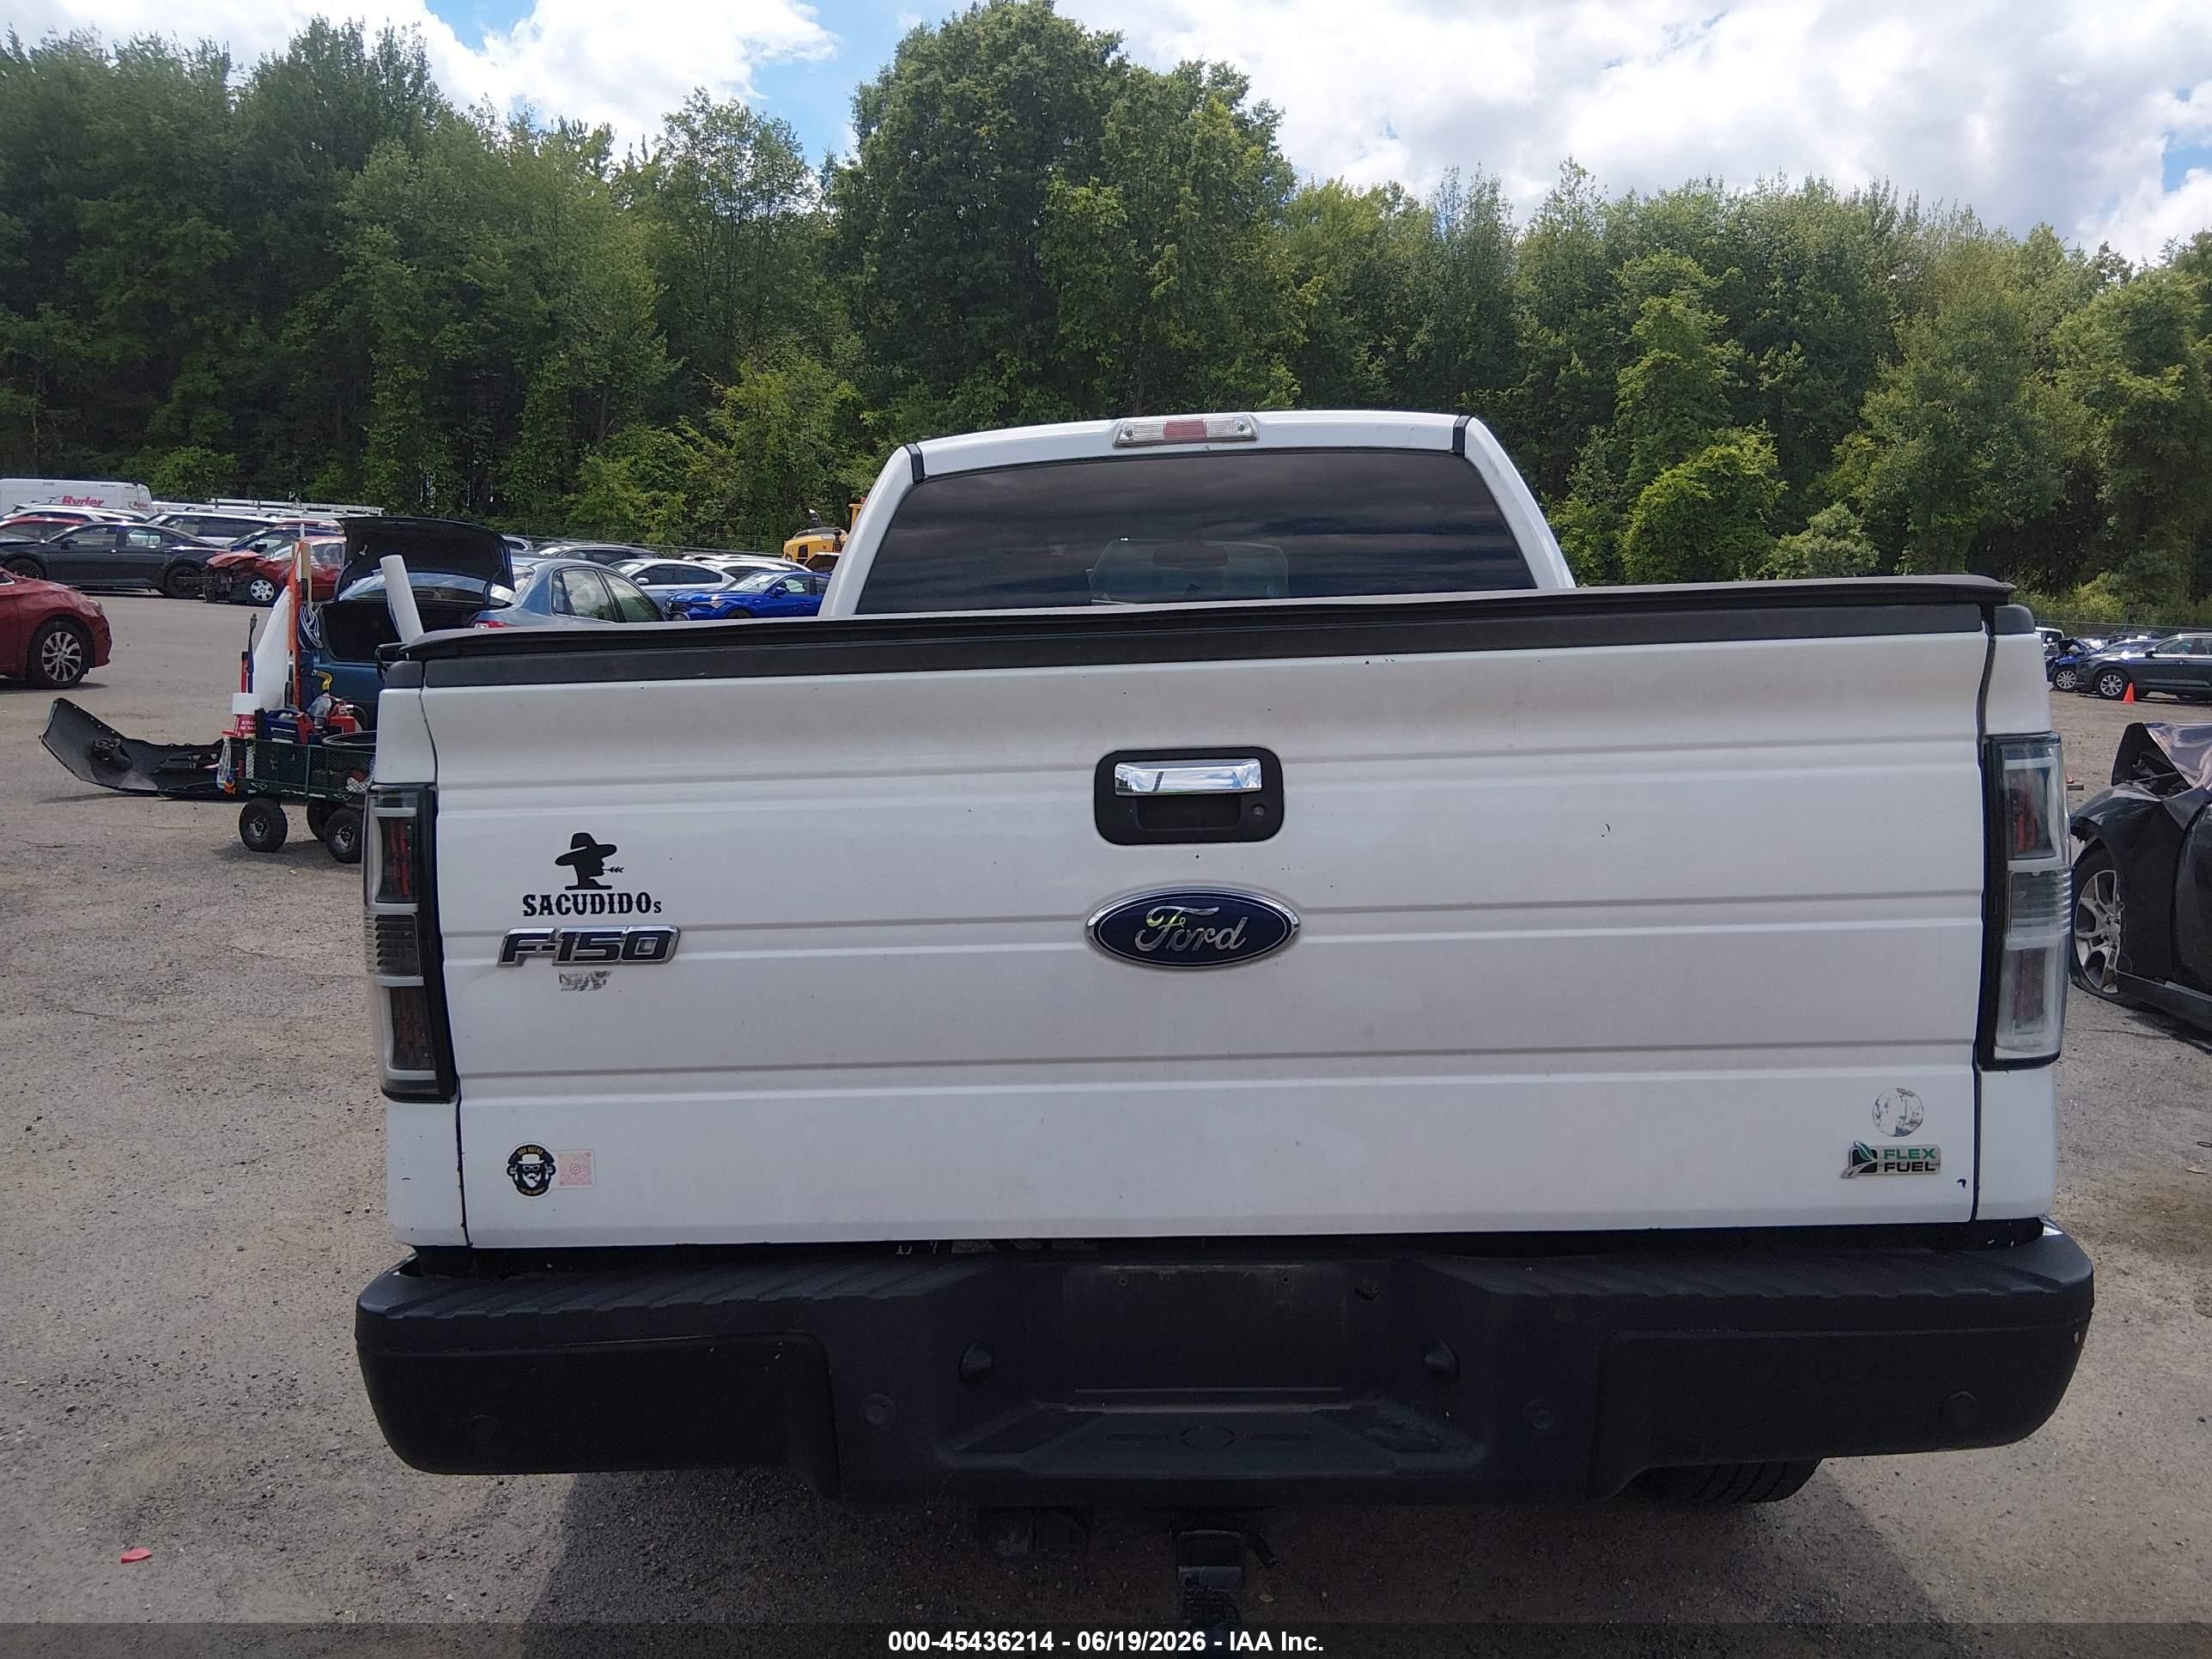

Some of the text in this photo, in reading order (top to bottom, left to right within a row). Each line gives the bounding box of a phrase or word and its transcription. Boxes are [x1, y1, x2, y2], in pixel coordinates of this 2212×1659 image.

[62, 495, 105, 507] Ryder
[1133, 904, 1249, 952] Ford
[496, 925, 681, 968] F-150
[1883, 1148, 1936, 1160] FLEX
[1883, 1161, 1936, 1173] FUEL
